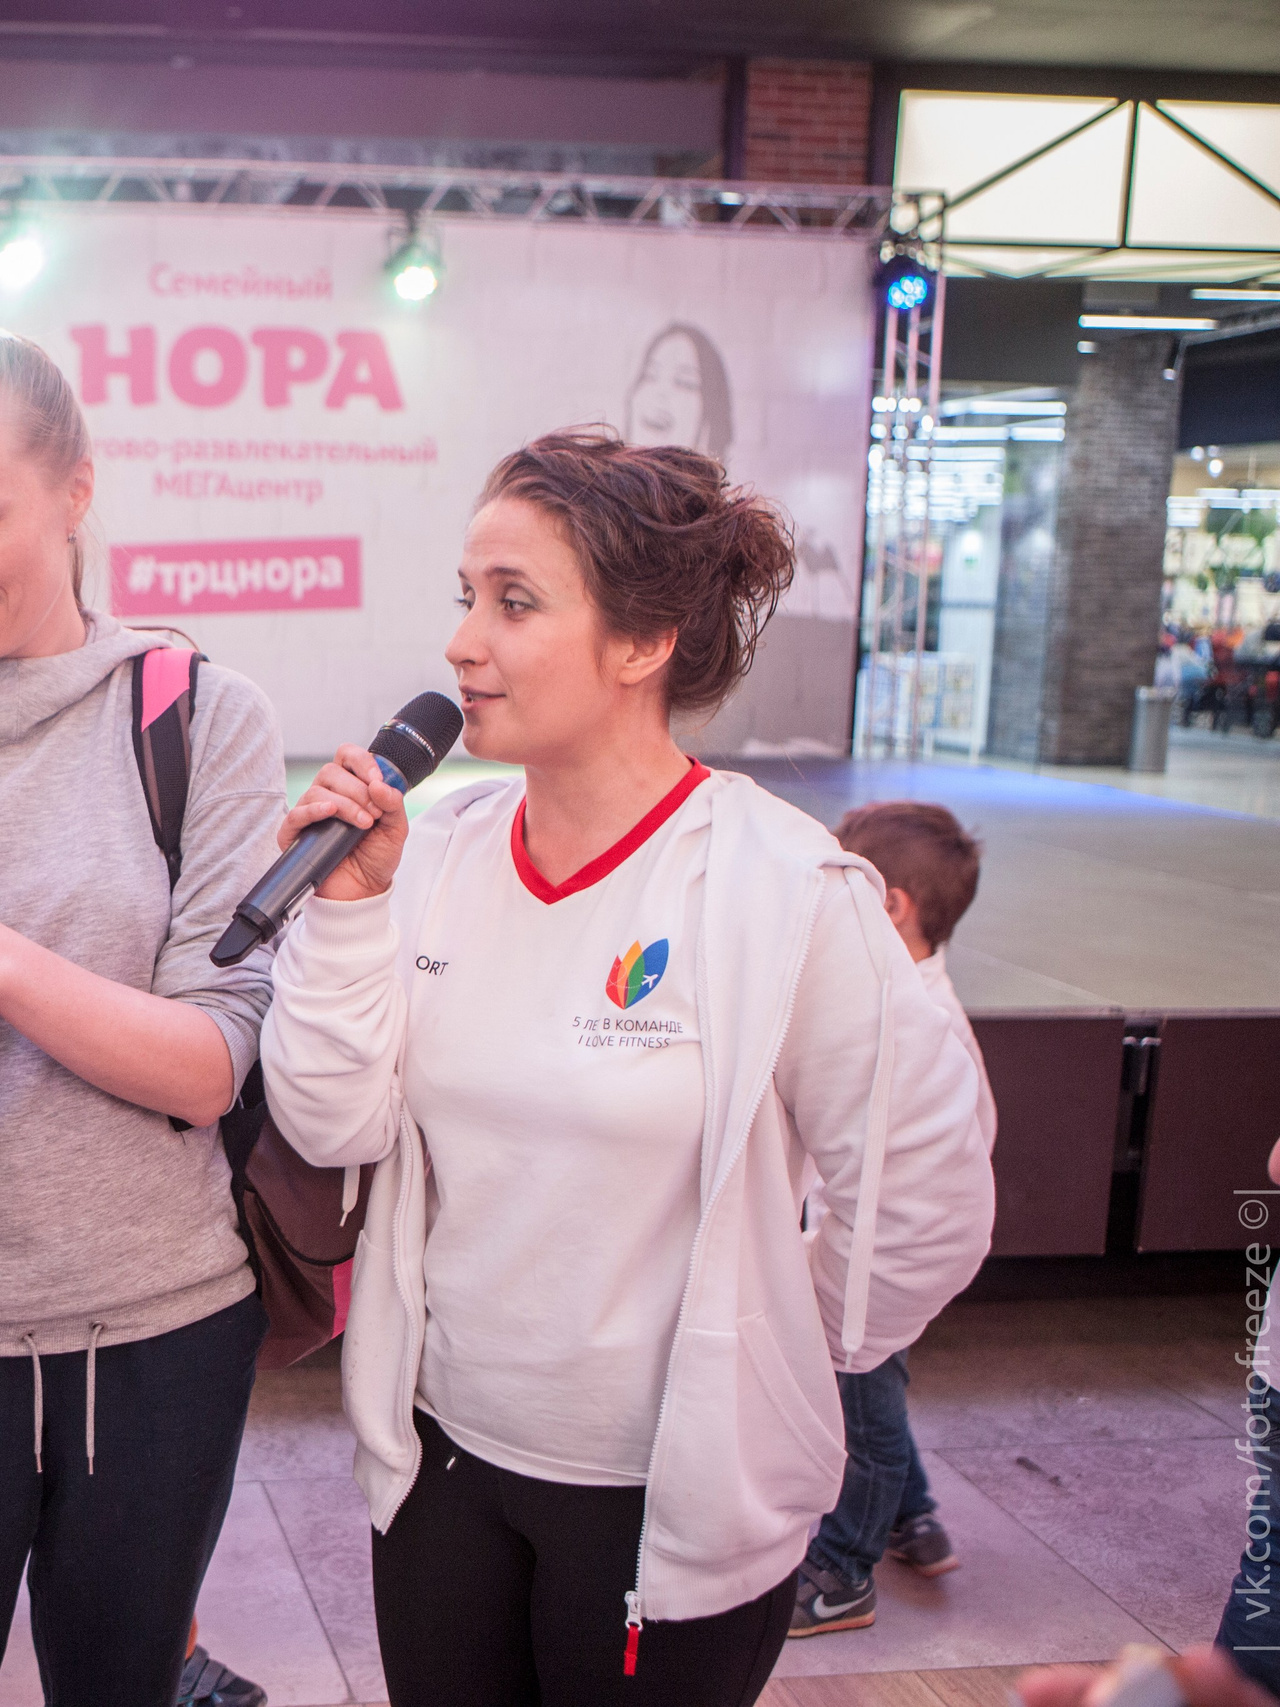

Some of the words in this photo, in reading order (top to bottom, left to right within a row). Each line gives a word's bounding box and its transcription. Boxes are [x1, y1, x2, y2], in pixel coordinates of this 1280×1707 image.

[149, 262, 333, 298] Семейный
[69, 323, 406, 413] НОРА
[92, 435, 439, 466] гово-развлекательный
[153, 470, 324, 506] МЕГАцентр
[128, 554, 344, 606] #трцнора
[415, 955, 449, 976] ORT
[572, 1015, 582, 1028] 5
[583, 1019, 600, 1032] ЛЕ
[603, 1018, 611, 1030] В
[615, 1019, 684, 1034] КОМАНДЕ
[585, 1035, 615, 1048] LOVE
[618, 1036, 672, 1049] FITNESS
